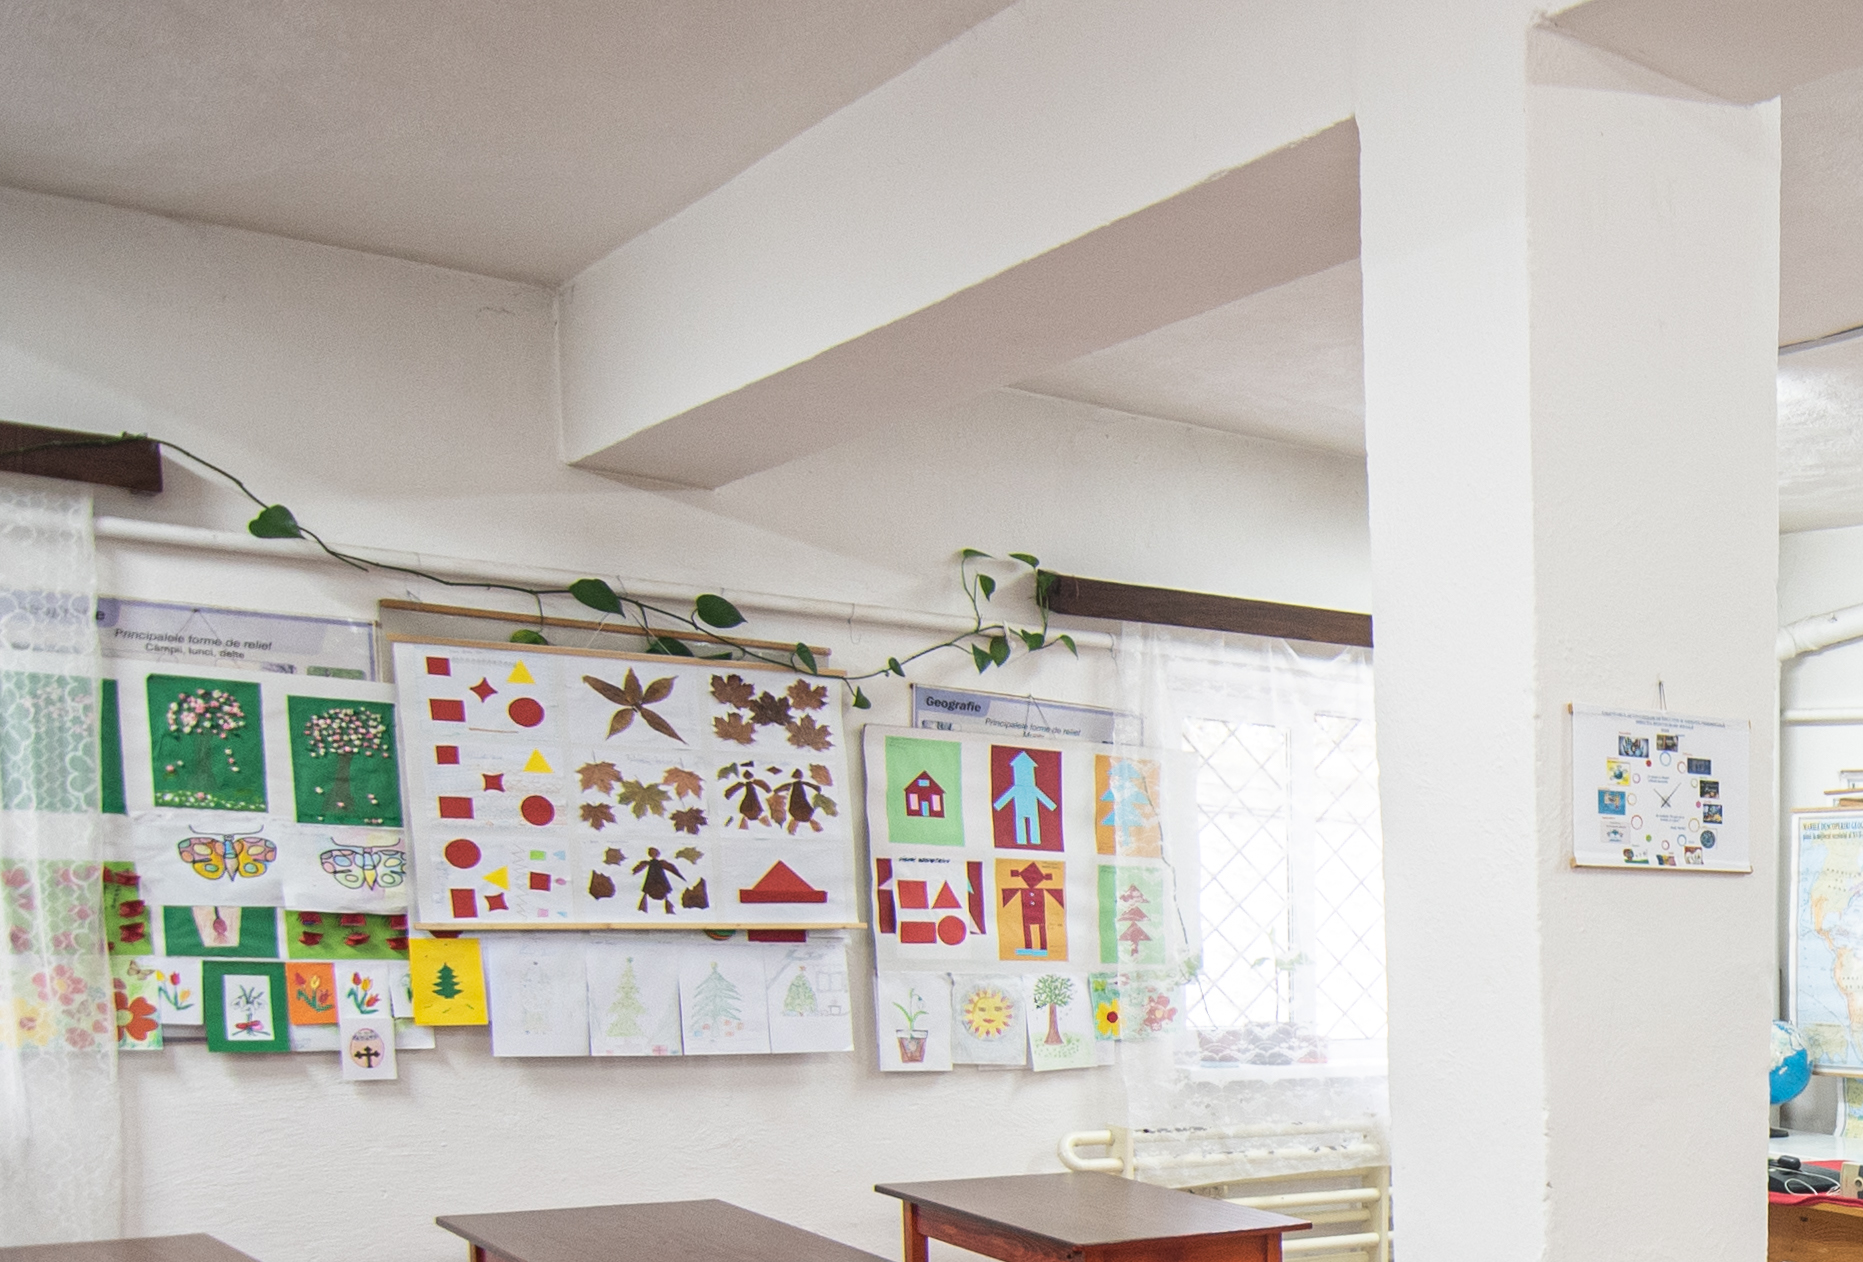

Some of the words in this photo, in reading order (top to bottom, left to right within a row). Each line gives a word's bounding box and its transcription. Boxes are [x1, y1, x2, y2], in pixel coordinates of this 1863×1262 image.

[113, 628, 185, 644] Principalele
[188, 634, 222, 646] forme
[225, 637, 241, 648] de
[243, 640, 272, 651] relief
[926, 696, 981, 712] Geografie
[985, 717, 1028, 730] Principalele
[1030, 723, 1051, 733] forme
[1051, 726, 1061, 734] de
[1062, 728, 1081, 737] relief
